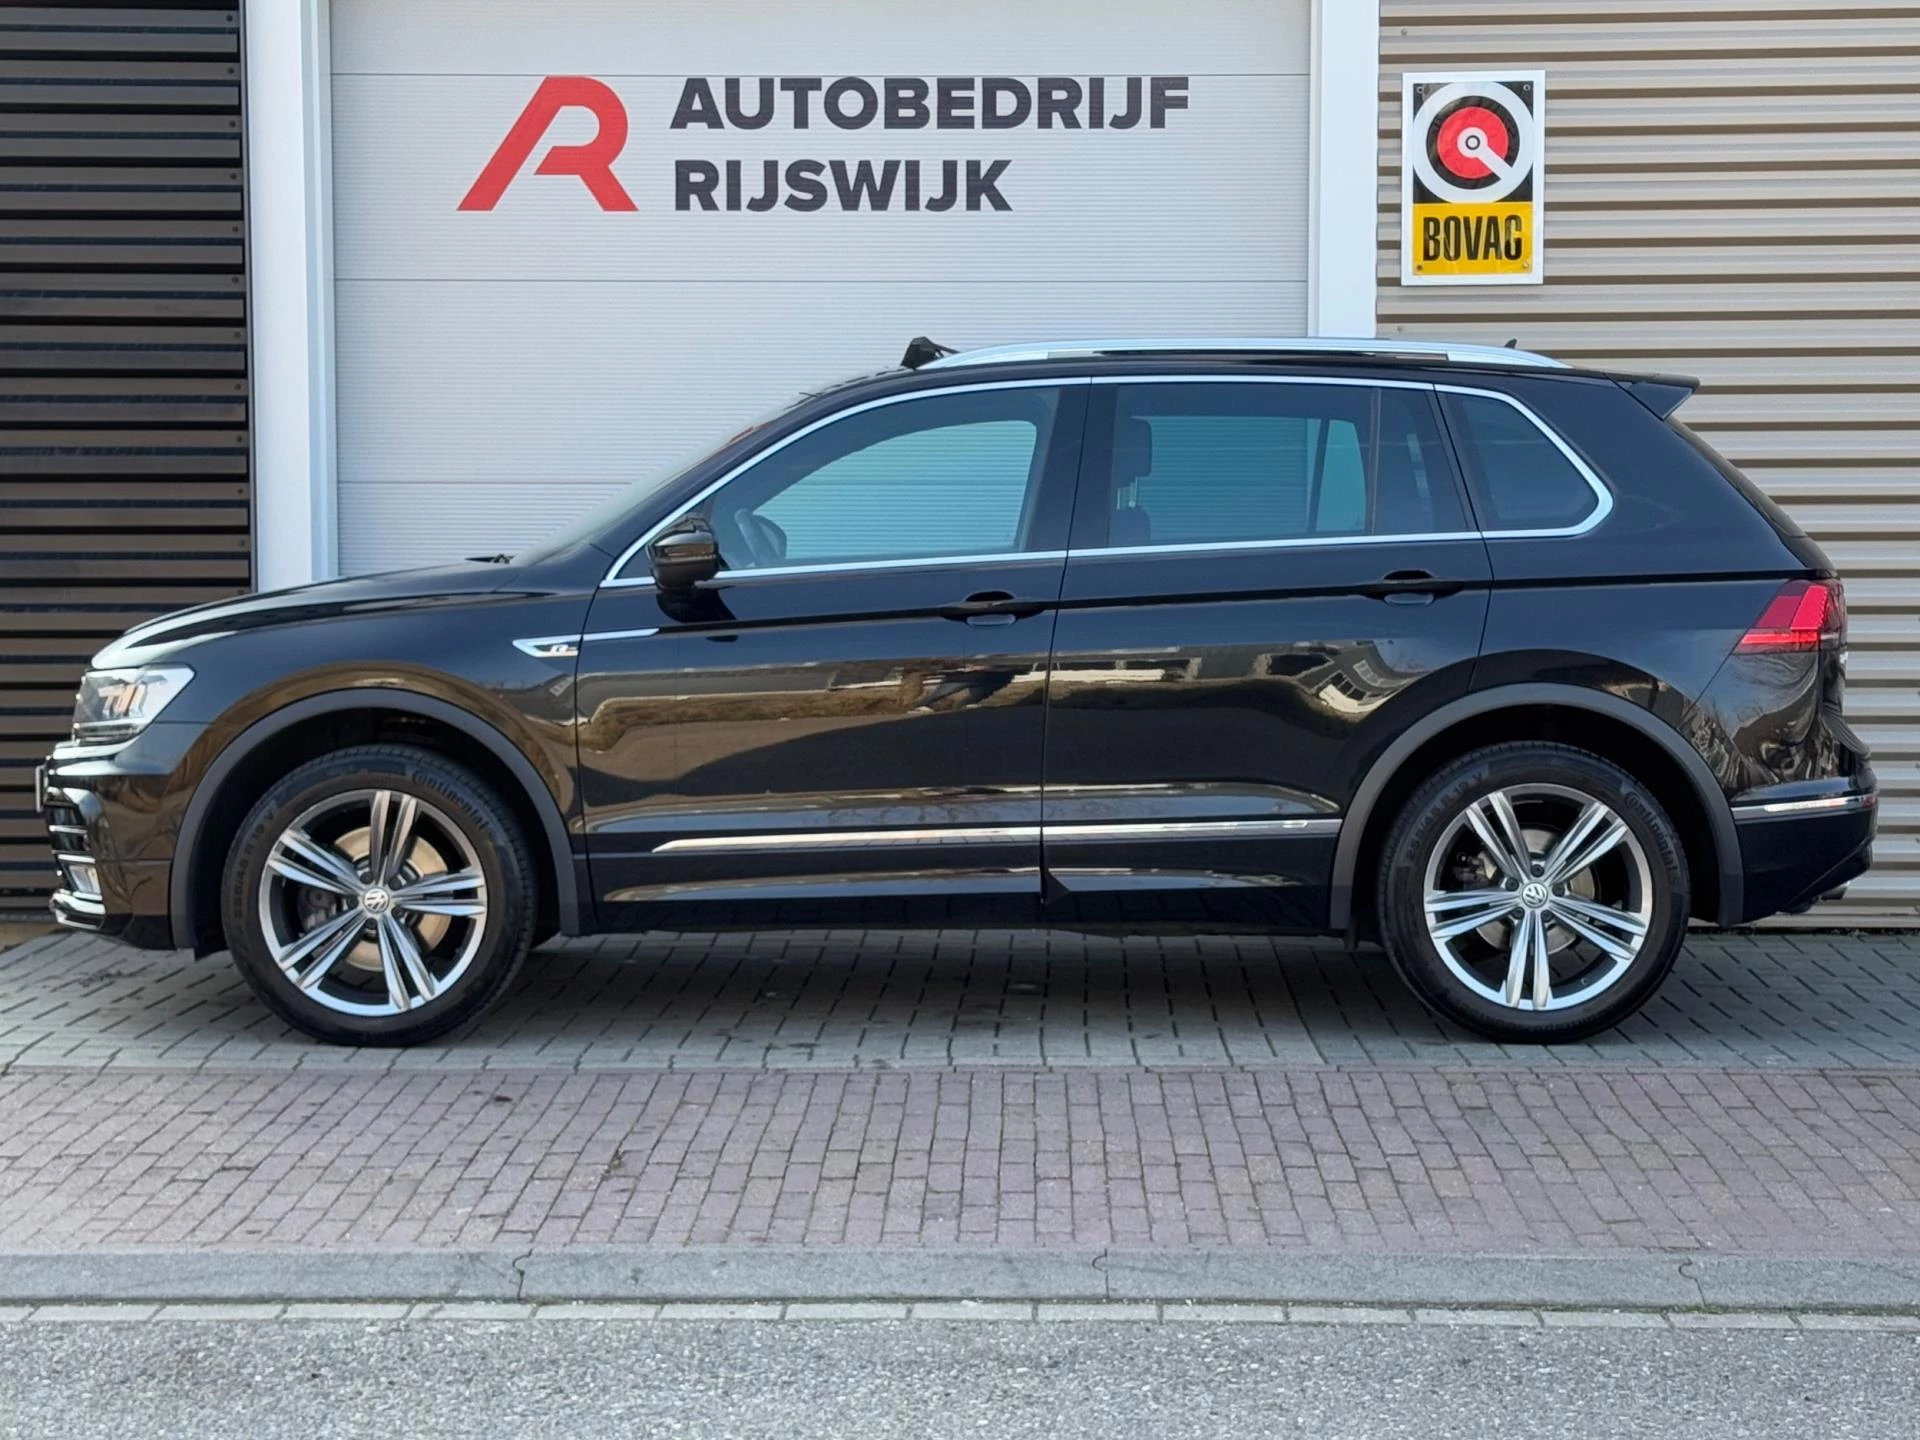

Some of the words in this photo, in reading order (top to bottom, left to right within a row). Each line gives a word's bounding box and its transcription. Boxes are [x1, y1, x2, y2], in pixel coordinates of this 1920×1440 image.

[671, 77, 1188, 129] AUTOBEDRIJF
[676, 160, 1011, 211] RIJSWIJK
[1422, 214, 1522, 262] BOVAG
[412, 769, 490, 831] Continental
[1624, 791, 1678, 872] Continental
